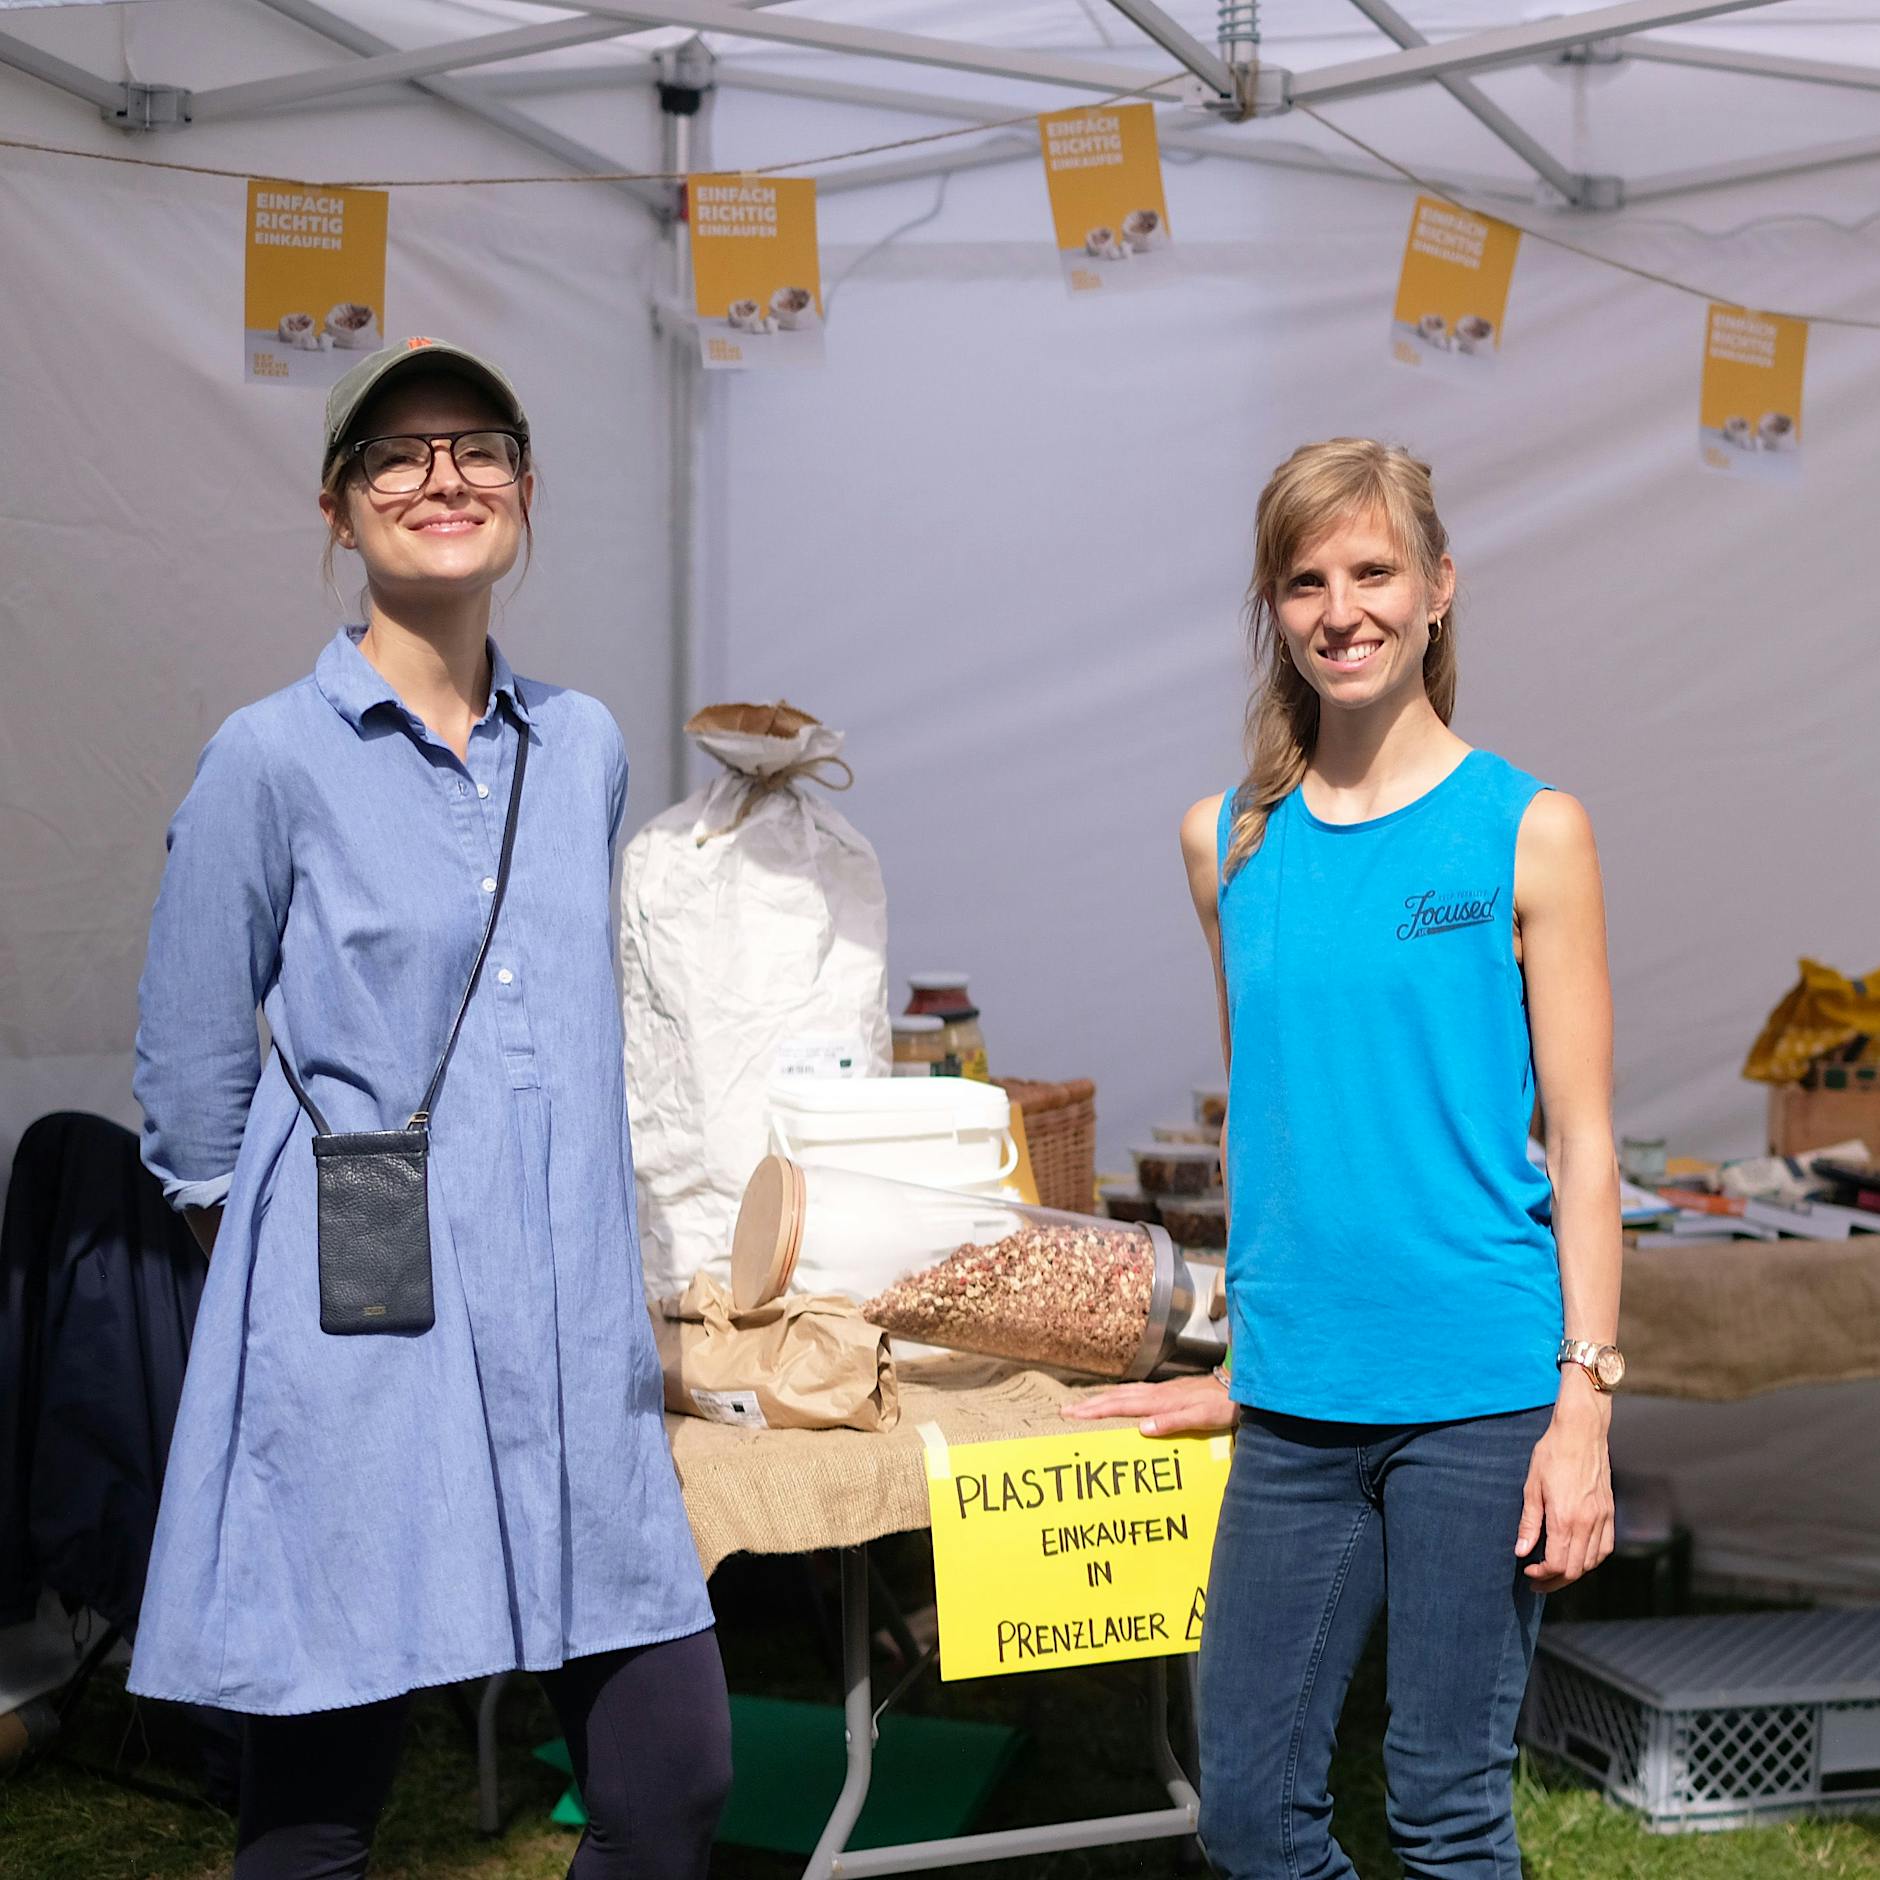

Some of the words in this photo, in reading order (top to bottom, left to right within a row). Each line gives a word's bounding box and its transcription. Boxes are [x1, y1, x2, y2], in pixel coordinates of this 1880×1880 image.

[1047, 116, 1120, 137] EINFACH
[1049, 134, 1122, 154] RICHTIG
[256, 192, 345, 214] EINFACH
[697, 186, 777, 204] EINFACH
[255, 211, 344, 235] RICHTIG
[698, 204, 777, 222] RICHTIG
[255, 232, 342, 250] EINKAUFEN
[699, 223, 777, 238] EINKAUFEN
[1397, 887, 1500, 940] Focused
[1042, 1514, 1188, 1556] EINKAUFEN
[1087, 1561, 1112, 1587] IN
[997, 1613, 1169, 1663] PRENZLAUER
